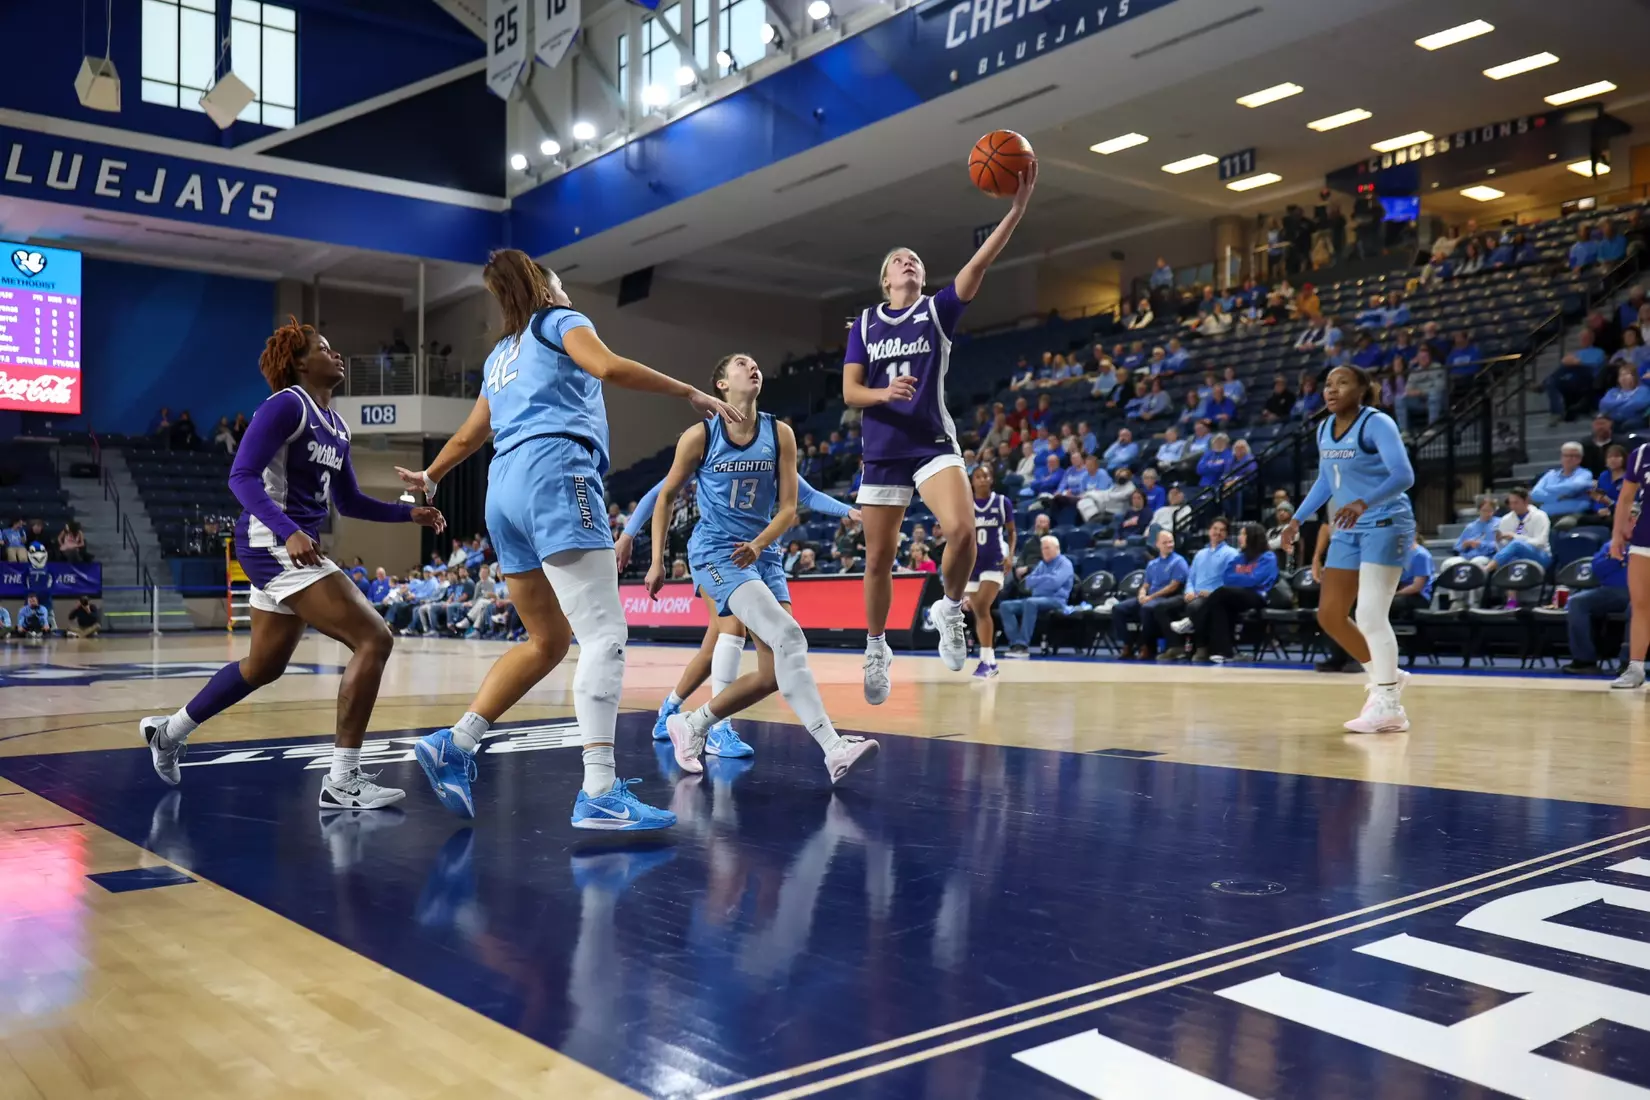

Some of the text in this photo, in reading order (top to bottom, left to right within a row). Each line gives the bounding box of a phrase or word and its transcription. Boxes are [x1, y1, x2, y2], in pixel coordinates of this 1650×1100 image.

[495, 4, 518, 56] 25
[977, 0, 1130, 75] BLUEJAYS
[1367, 118, 1529, 174] CONCESSIONS
[1221, 151, 1251, 178] 111
[866, 335, 932, 363] Wildcats
[0, 370, 77, 404] oca-Cola
[362, 404, 395, 424] 108
[712, 460, 775, 474] CREIGHTON
[1332, 463, 1341, 490] 1
[314, 469, 332, 501] 3
[728, 477, 760, 510] 13
[573, 474, 595, 531] BLUEJAYS
[3, 573, 23, 585] THE
[623, 596, 693, 615] FAN WORK
